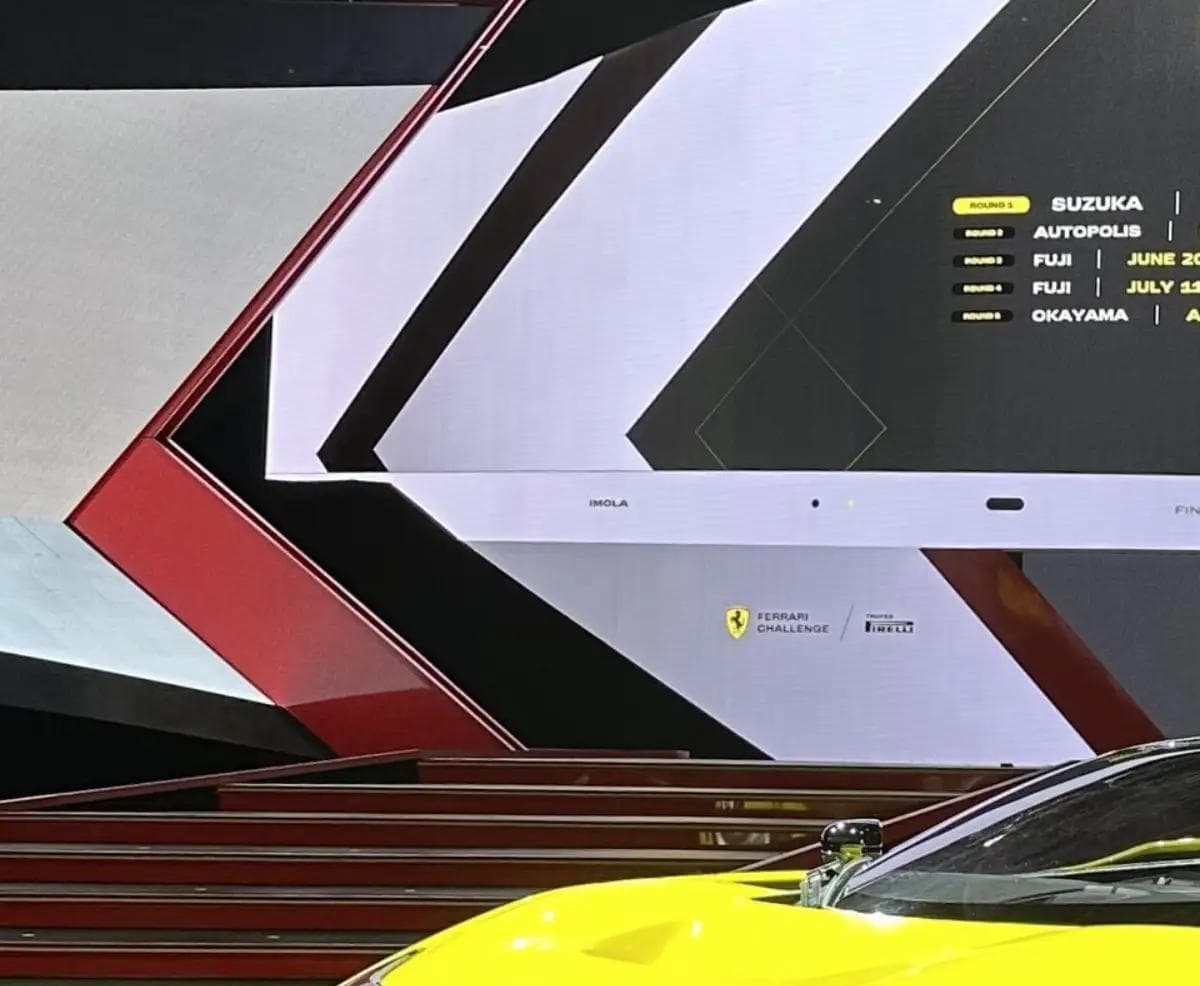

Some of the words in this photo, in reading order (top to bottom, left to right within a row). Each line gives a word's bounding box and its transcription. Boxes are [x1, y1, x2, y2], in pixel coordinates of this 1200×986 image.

[969, 201, 1004, 209] ROUND
[1051, 195, 1144, 212] SUZUKA
[1033, 224, 1142, 240] AUTOPOLIS
[1033, 253, 1072, 268] FUJI
[1127, 252, 1175, 267] JUNE
[1032, 280, 1072, 295] FUJI
[1126, 280, 1174, 295] JULY
[1031, 308, 1129, 323] OKAYAMA
[589, 499, 628, 508] IMOLA
[757, 612, 809, 622] FERRARI
[757, 624, 830, 634] CHALLENGE
